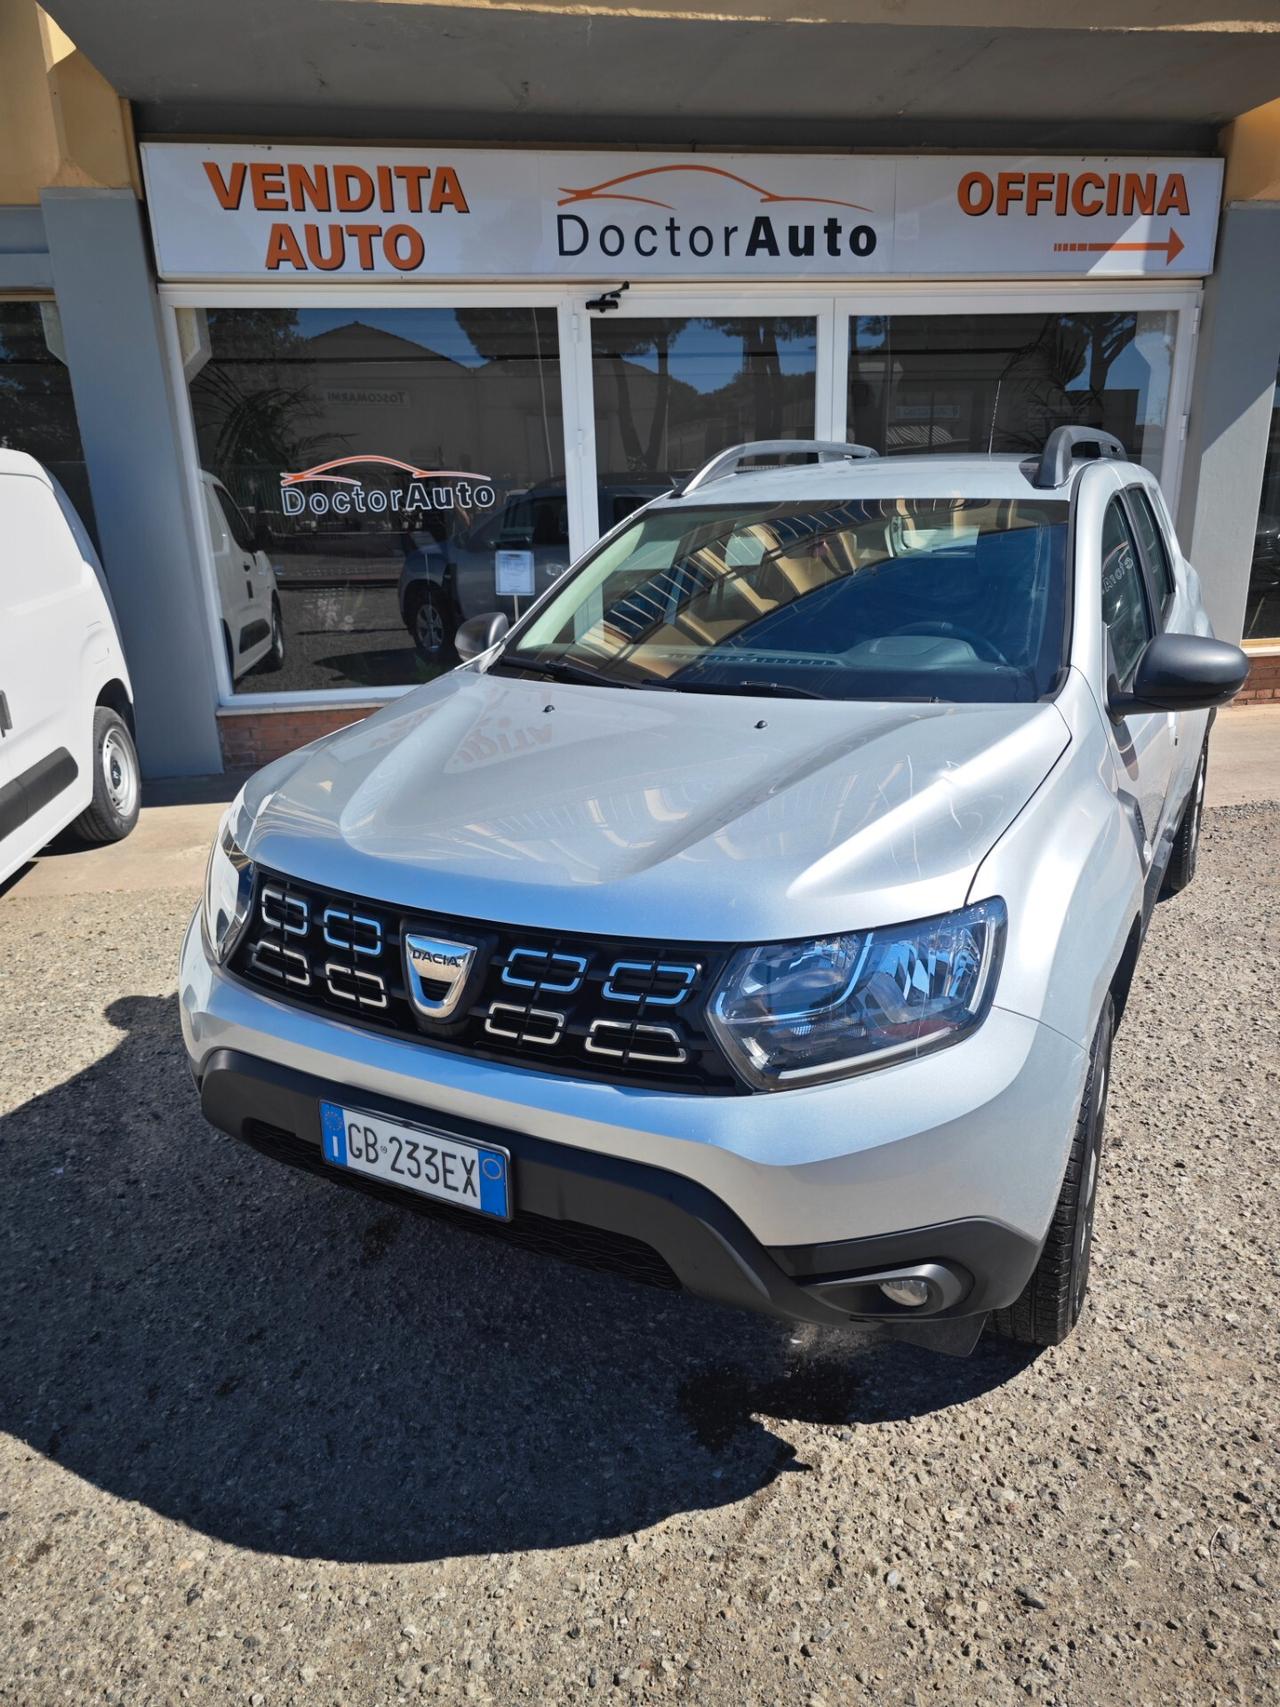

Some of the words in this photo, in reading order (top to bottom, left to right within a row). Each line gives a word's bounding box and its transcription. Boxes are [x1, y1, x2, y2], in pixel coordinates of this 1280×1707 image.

[203, 161, 470, 213] VENDITA
[957, 171, 1190, 217] OFFICINA
[265, 223, 425, 271] AUTO
[557, 214, 877, 257] DoctorAuto
[280, 482, 495, 516] DoctorAuto
[412, 949, 461, 968] DACIA
